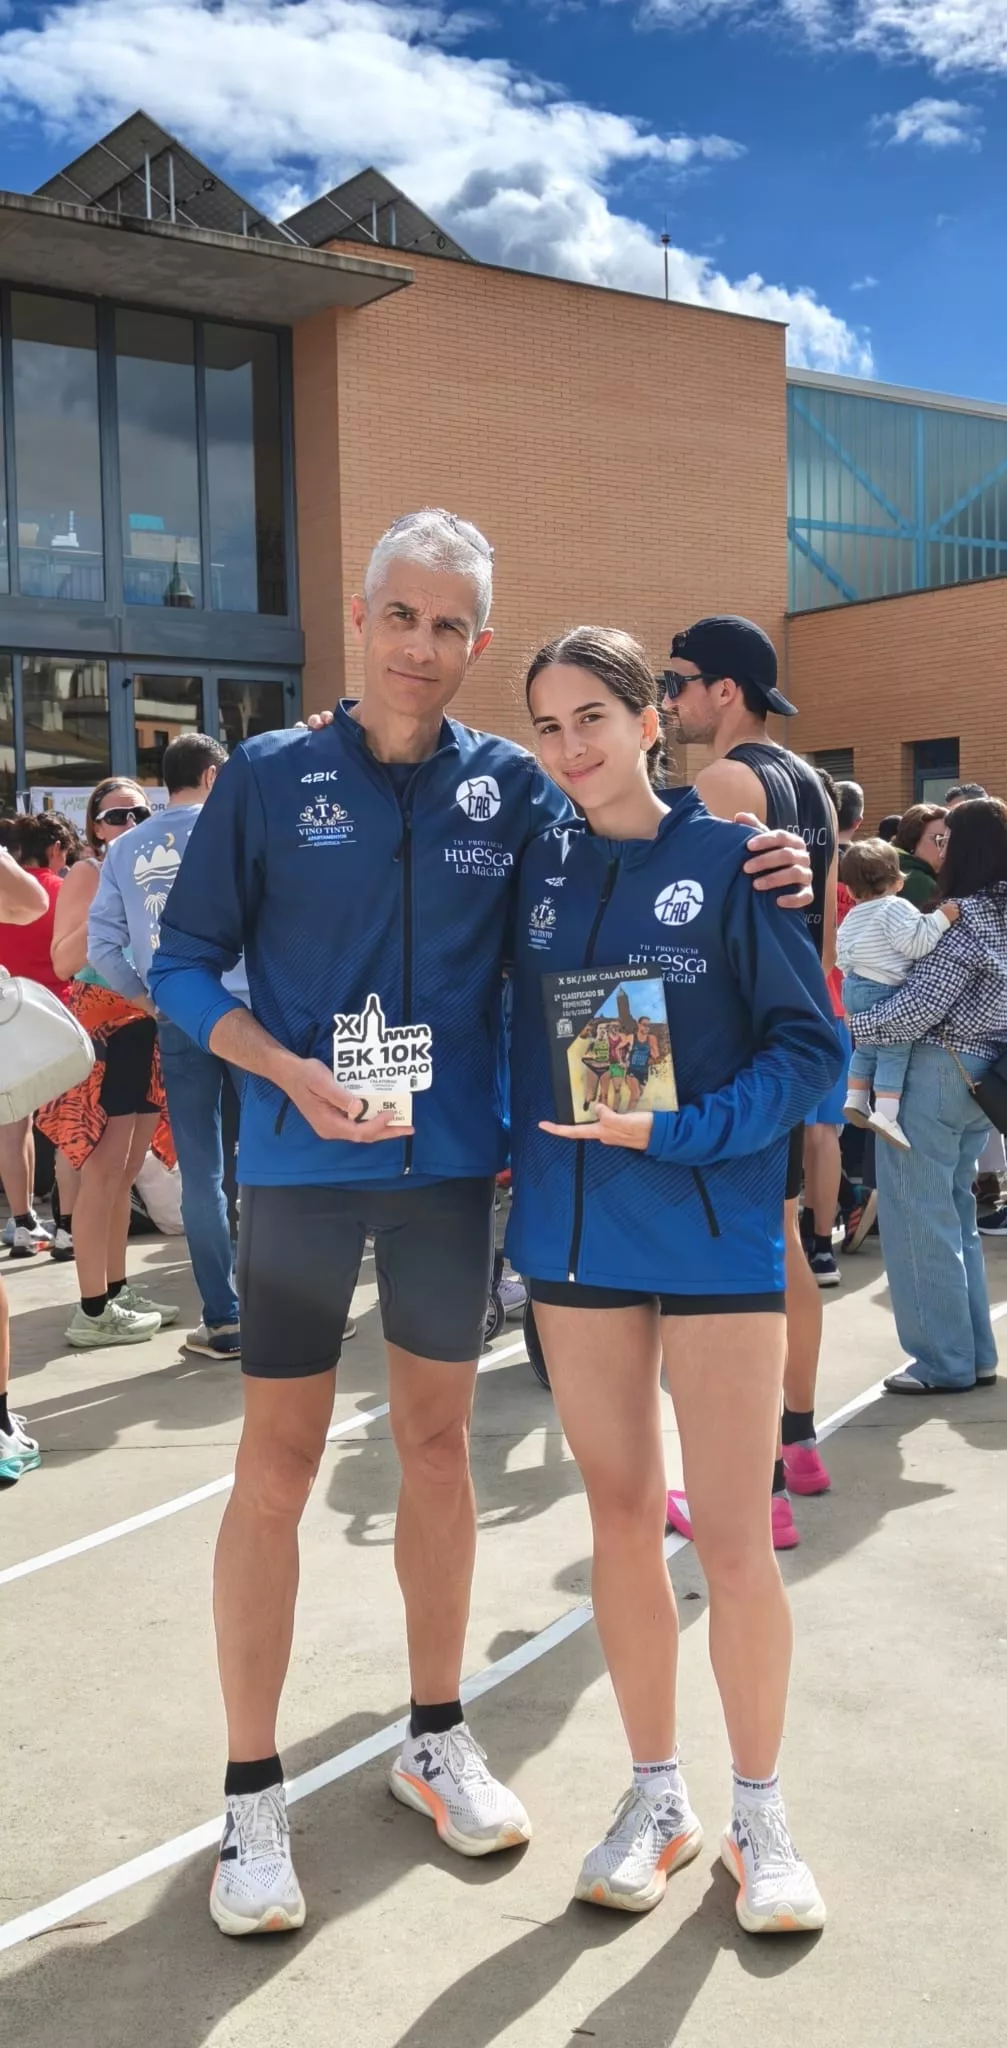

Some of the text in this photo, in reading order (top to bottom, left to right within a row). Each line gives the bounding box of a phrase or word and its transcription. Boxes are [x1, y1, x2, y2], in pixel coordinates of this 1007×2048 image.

[300, 770, 339, 784] 42K
[315, 803, 330, 818] T
[468, 796, 490, 818] CAB
[299, 825, 354, 836] VINO TINTO
[661, 901, 690, 923] CAB
[599, 968, 649, 980] CALATORAO
[336, 1016, 357, 1036] X
[337, 1043, 430, 1068] 5K 10K
[336, 1063, 430, 1082] CALATORAO
[353, 1098, 369, 1124] 2
[383, 1101, 397, 1110] 5K
